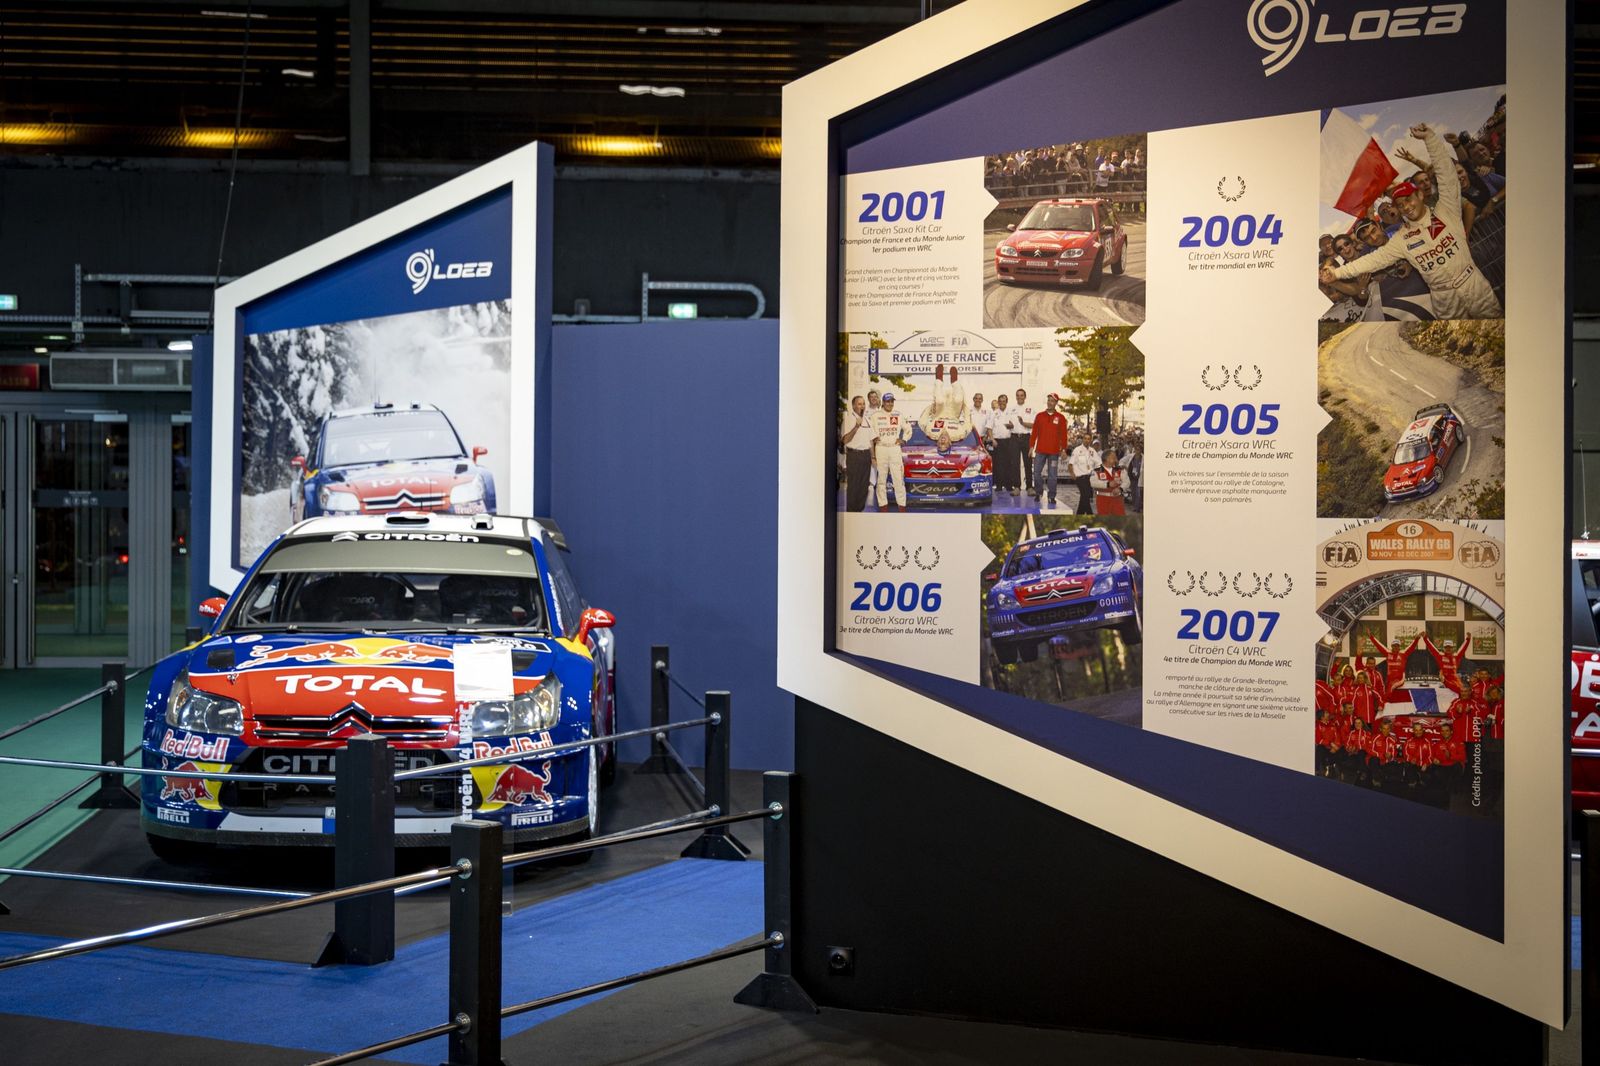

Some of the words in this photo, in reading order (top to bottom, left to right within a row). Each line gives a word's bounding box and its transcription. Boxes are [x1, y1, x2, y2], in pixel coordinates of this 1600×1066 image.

[1315, 3, 1467, 43] LOEB
[859, 190, 945, 223] 2001
[863, 226, 891, 235] Citroën
[893, 225, 913, 234] Saxo
[915, 225, 926, 233] Kit
[928, 224, 942, 232] Car
[1179, 214, 1283, 247] 2004
[883, 246, 906, 254] podium
[1188, 252, 1220, 261] Citroën
[1224, 251, 1250, 260] Xsara
[1252, 250, 1275, 259] WRC
[433, 261, 493, 279] LOEB
[893, 354, 932, 362] RALLYE
[936, 354, 949, 362] DE
[954, 353, 996, 361] FRANCE
[1178, 404, 1280, 435] 2005
[1182, 440, 1217, 449] Citroën
[1220, 440, 1250, 449] Xsara
[1252, 440, 1276, 449] WRC
[1202, 452, 1237, 460] Champion
[910, 484, 959, 493] Xsara
[1403, 526, 1417, 534] 16
[1035, 536, 1083, 549] CITROËN
[1370, 539, 1403, 550] WALES
[1406, 539, 1435, 550] RALLY
[1437, 539, 1450, 550] GB
[1024, 578, 1082, 592] TOTAL
[851, 581, 941, 612] 2006
[854, 615, 886, 625] Citroën
[889, 616, 914, 625] Xsara
[917, 616, 938, 625] WRC
[1177, 608, 1280, 642] 2007
[872, 627, 904, 635] Champion
[1189, 644, 1224, 655] Citroën
[1227, 646, 1240, 655] C4
[1243, 646, 1266, 656] WRC
[1201, 657, 1236, 666] Champion
[1249, 659, 1273, 667] Monde
[1275, 659, 1292, 667] WRC
[275, 673, 448, 696] TOTAL
[1166, 674, 1194, 682] remporté
[1205, 675, 1221, 684] rallye
[1208, 693, 1233, 701] poursuit
[1156, 699, 1173, 707] rallye
[1222, 702, 1245, 710] signant
[459, 704, 472, 744] WRC
[1473, 717, 1481, 737] DPPI
[1472, 743, 1483, 774] photos
[1472, 776, 1481, 806] Crédits
[157, 806, 189, 824] PIRELLI
[511, 810, 553, 826] PIRELLI
